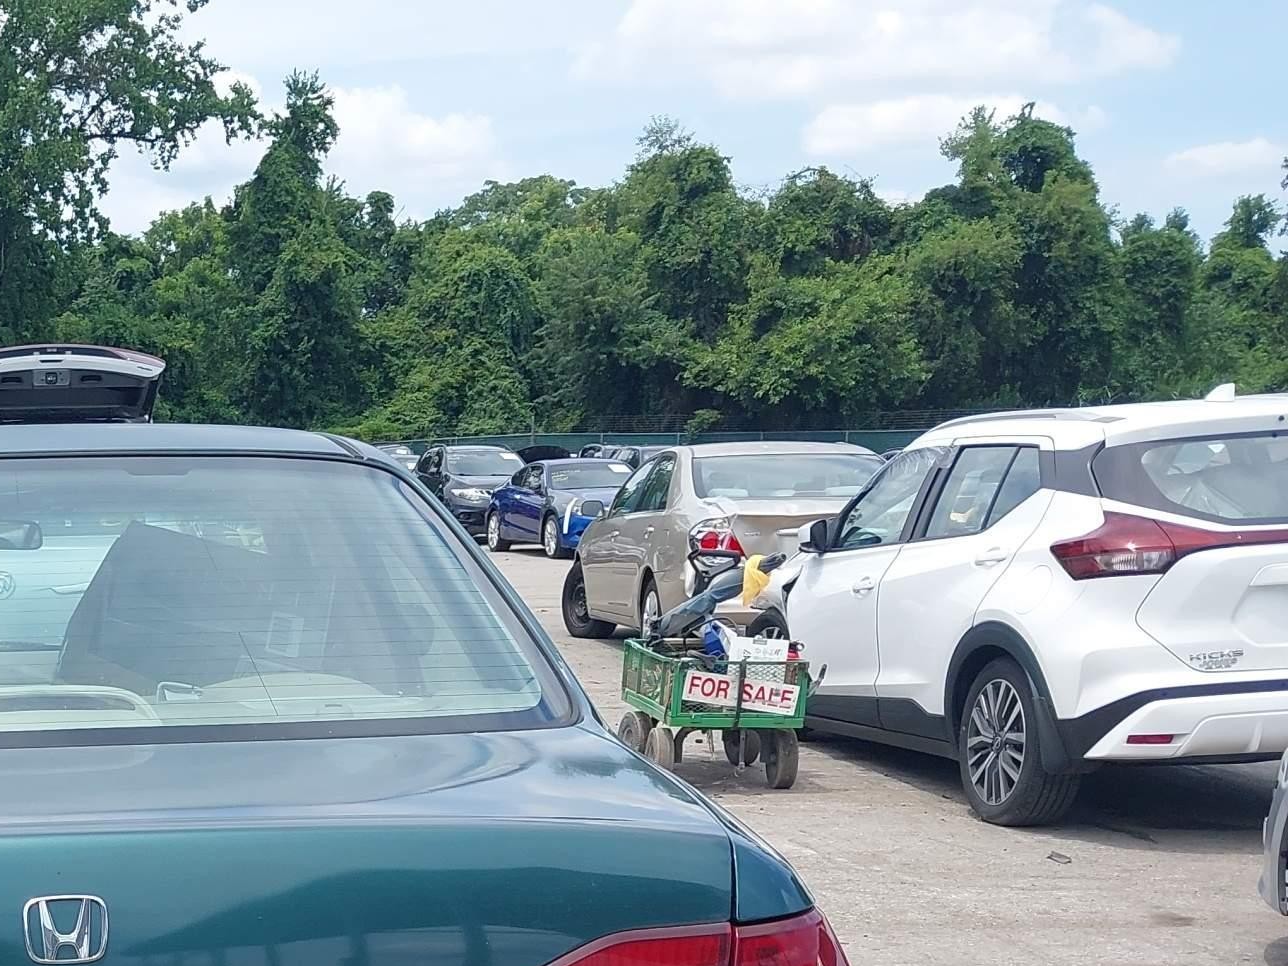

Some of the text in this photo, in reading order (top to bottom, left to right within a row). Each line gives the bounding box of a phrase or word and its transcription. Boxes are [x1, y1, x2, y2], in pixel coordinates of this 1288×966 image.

[1189, 649, 1244, 661] KICKS
[688, 676, 794, 709] FOR SALE
